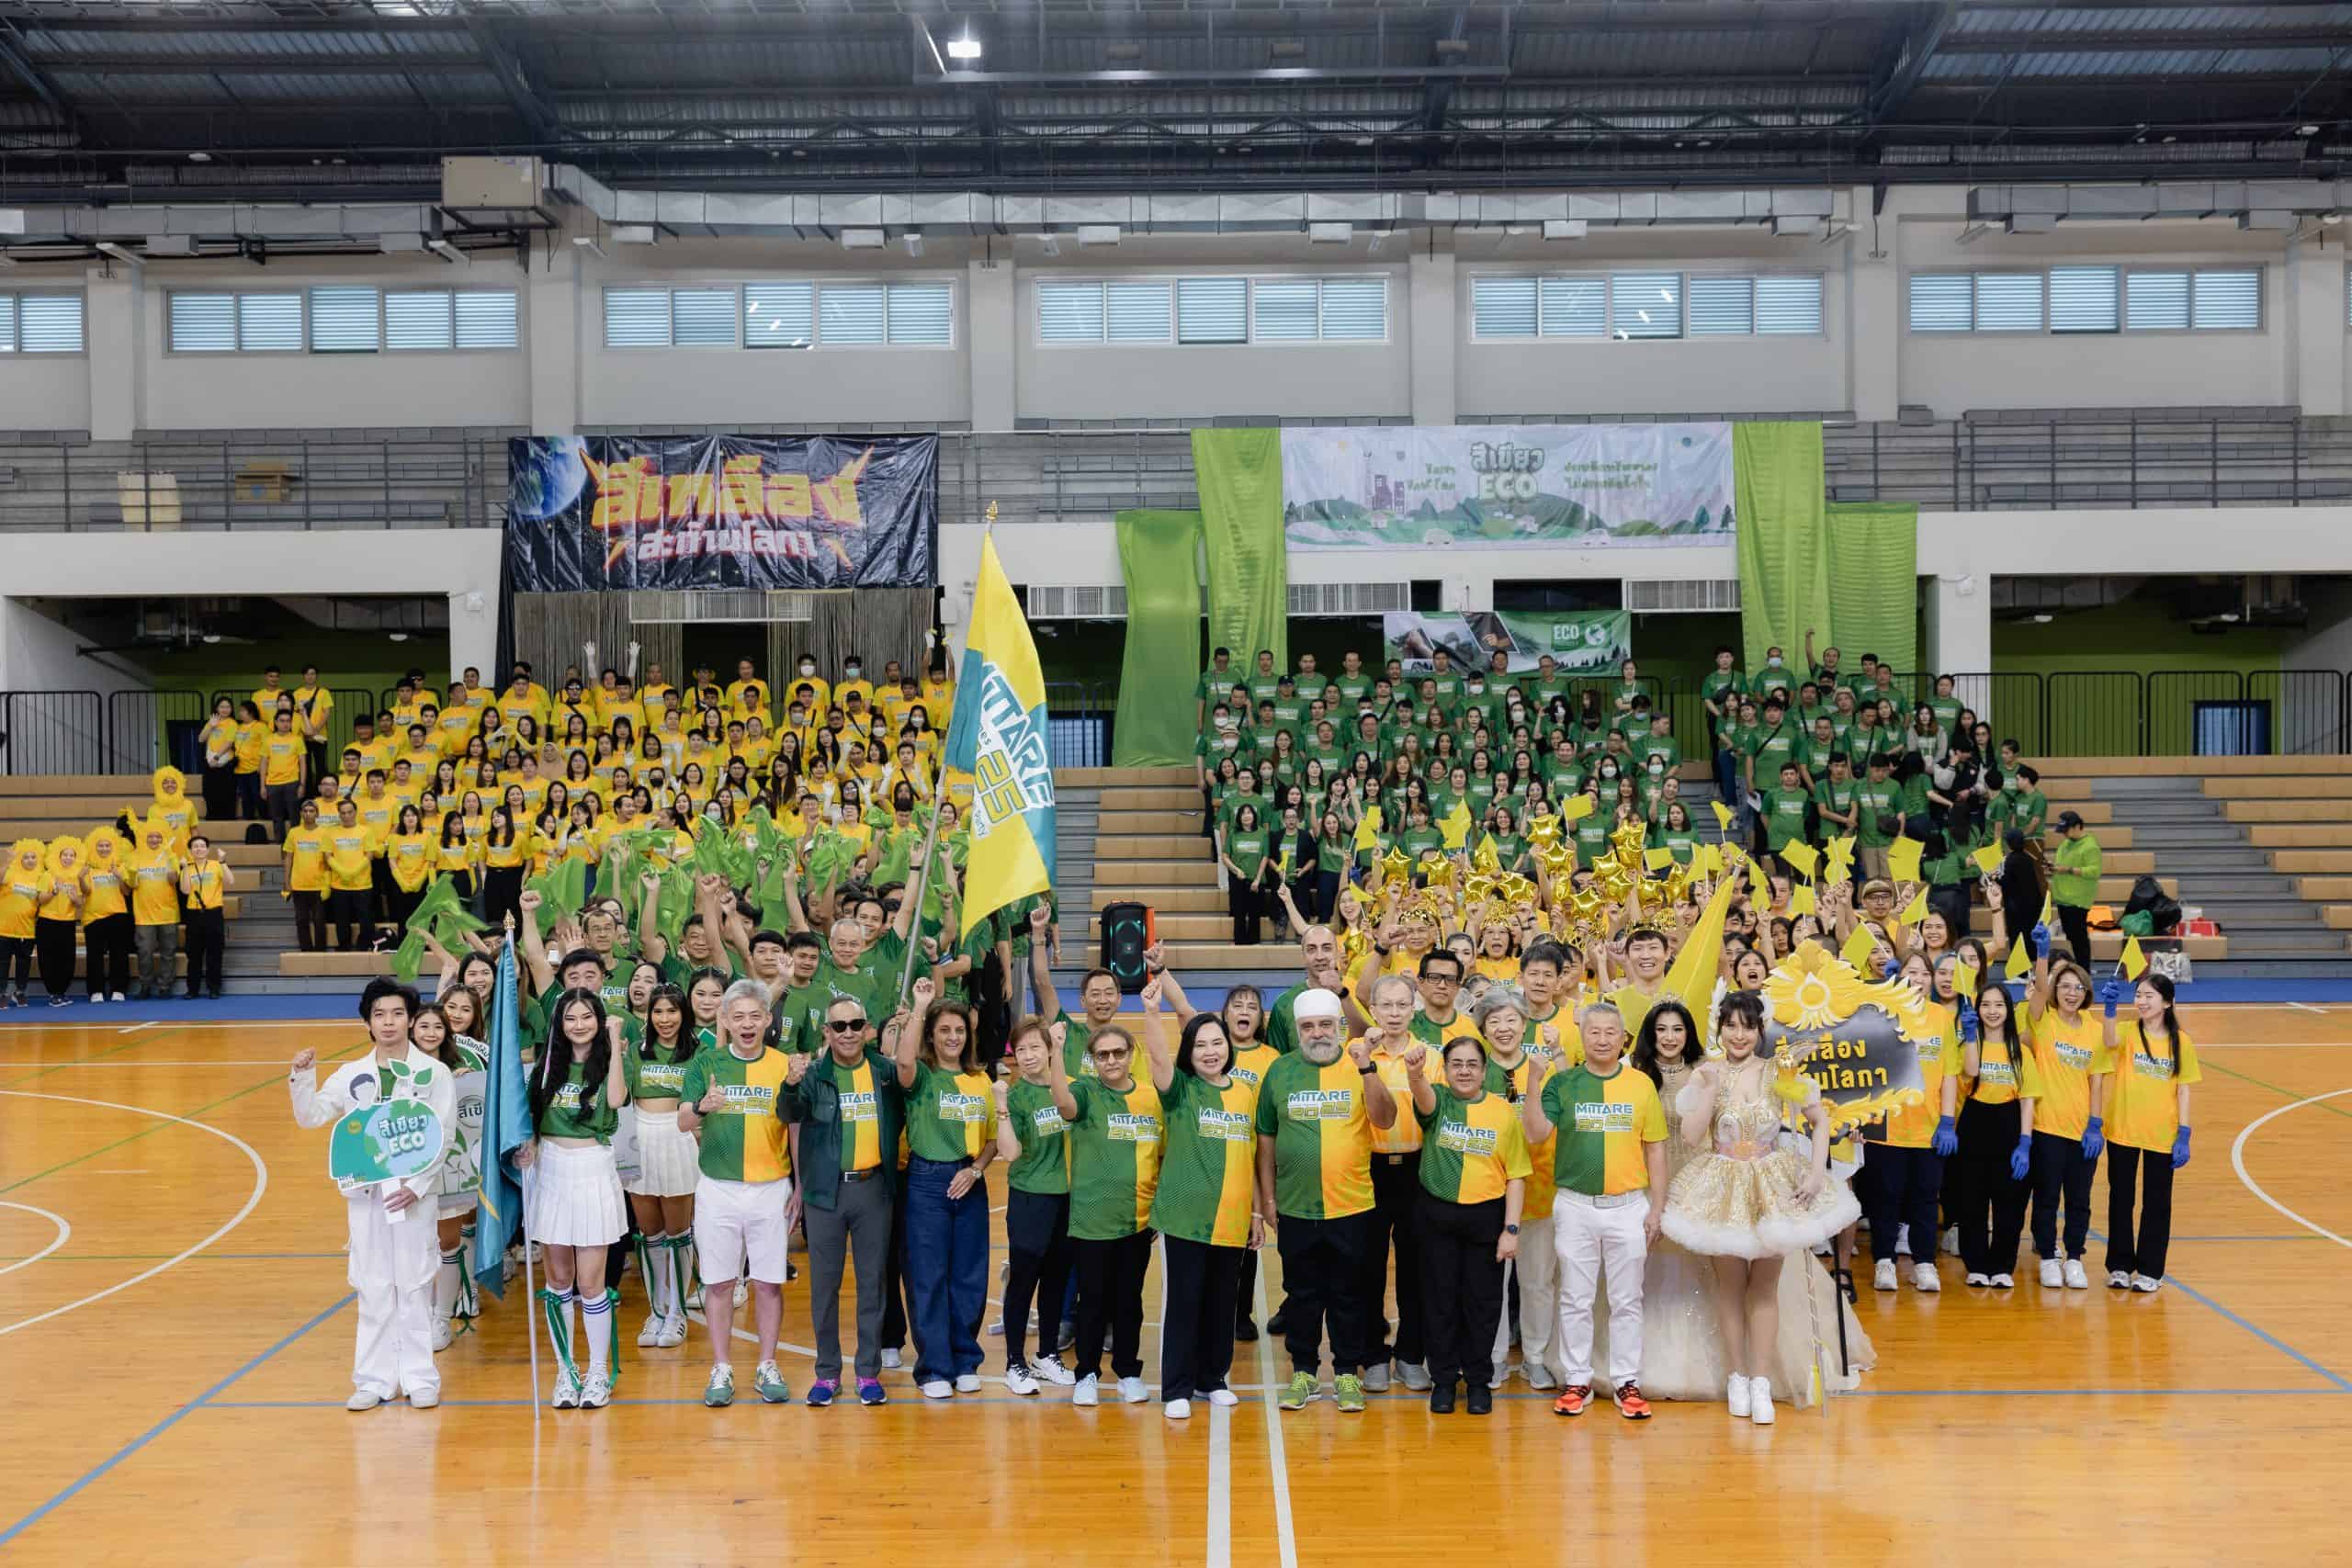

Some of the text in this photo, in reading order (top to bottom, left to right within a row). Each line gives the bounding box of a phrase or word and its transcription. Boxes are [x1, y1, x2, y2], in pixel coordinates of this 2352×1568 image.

[592, 456, 864, 528] สีเหลือง
[1477, 472, 1538, 502] ECO
[1554, 625, 1579, 640] ECO
[379, 1115, 428, 1138] สีเขียว
[389, 1131, 425, 1157] ECO
